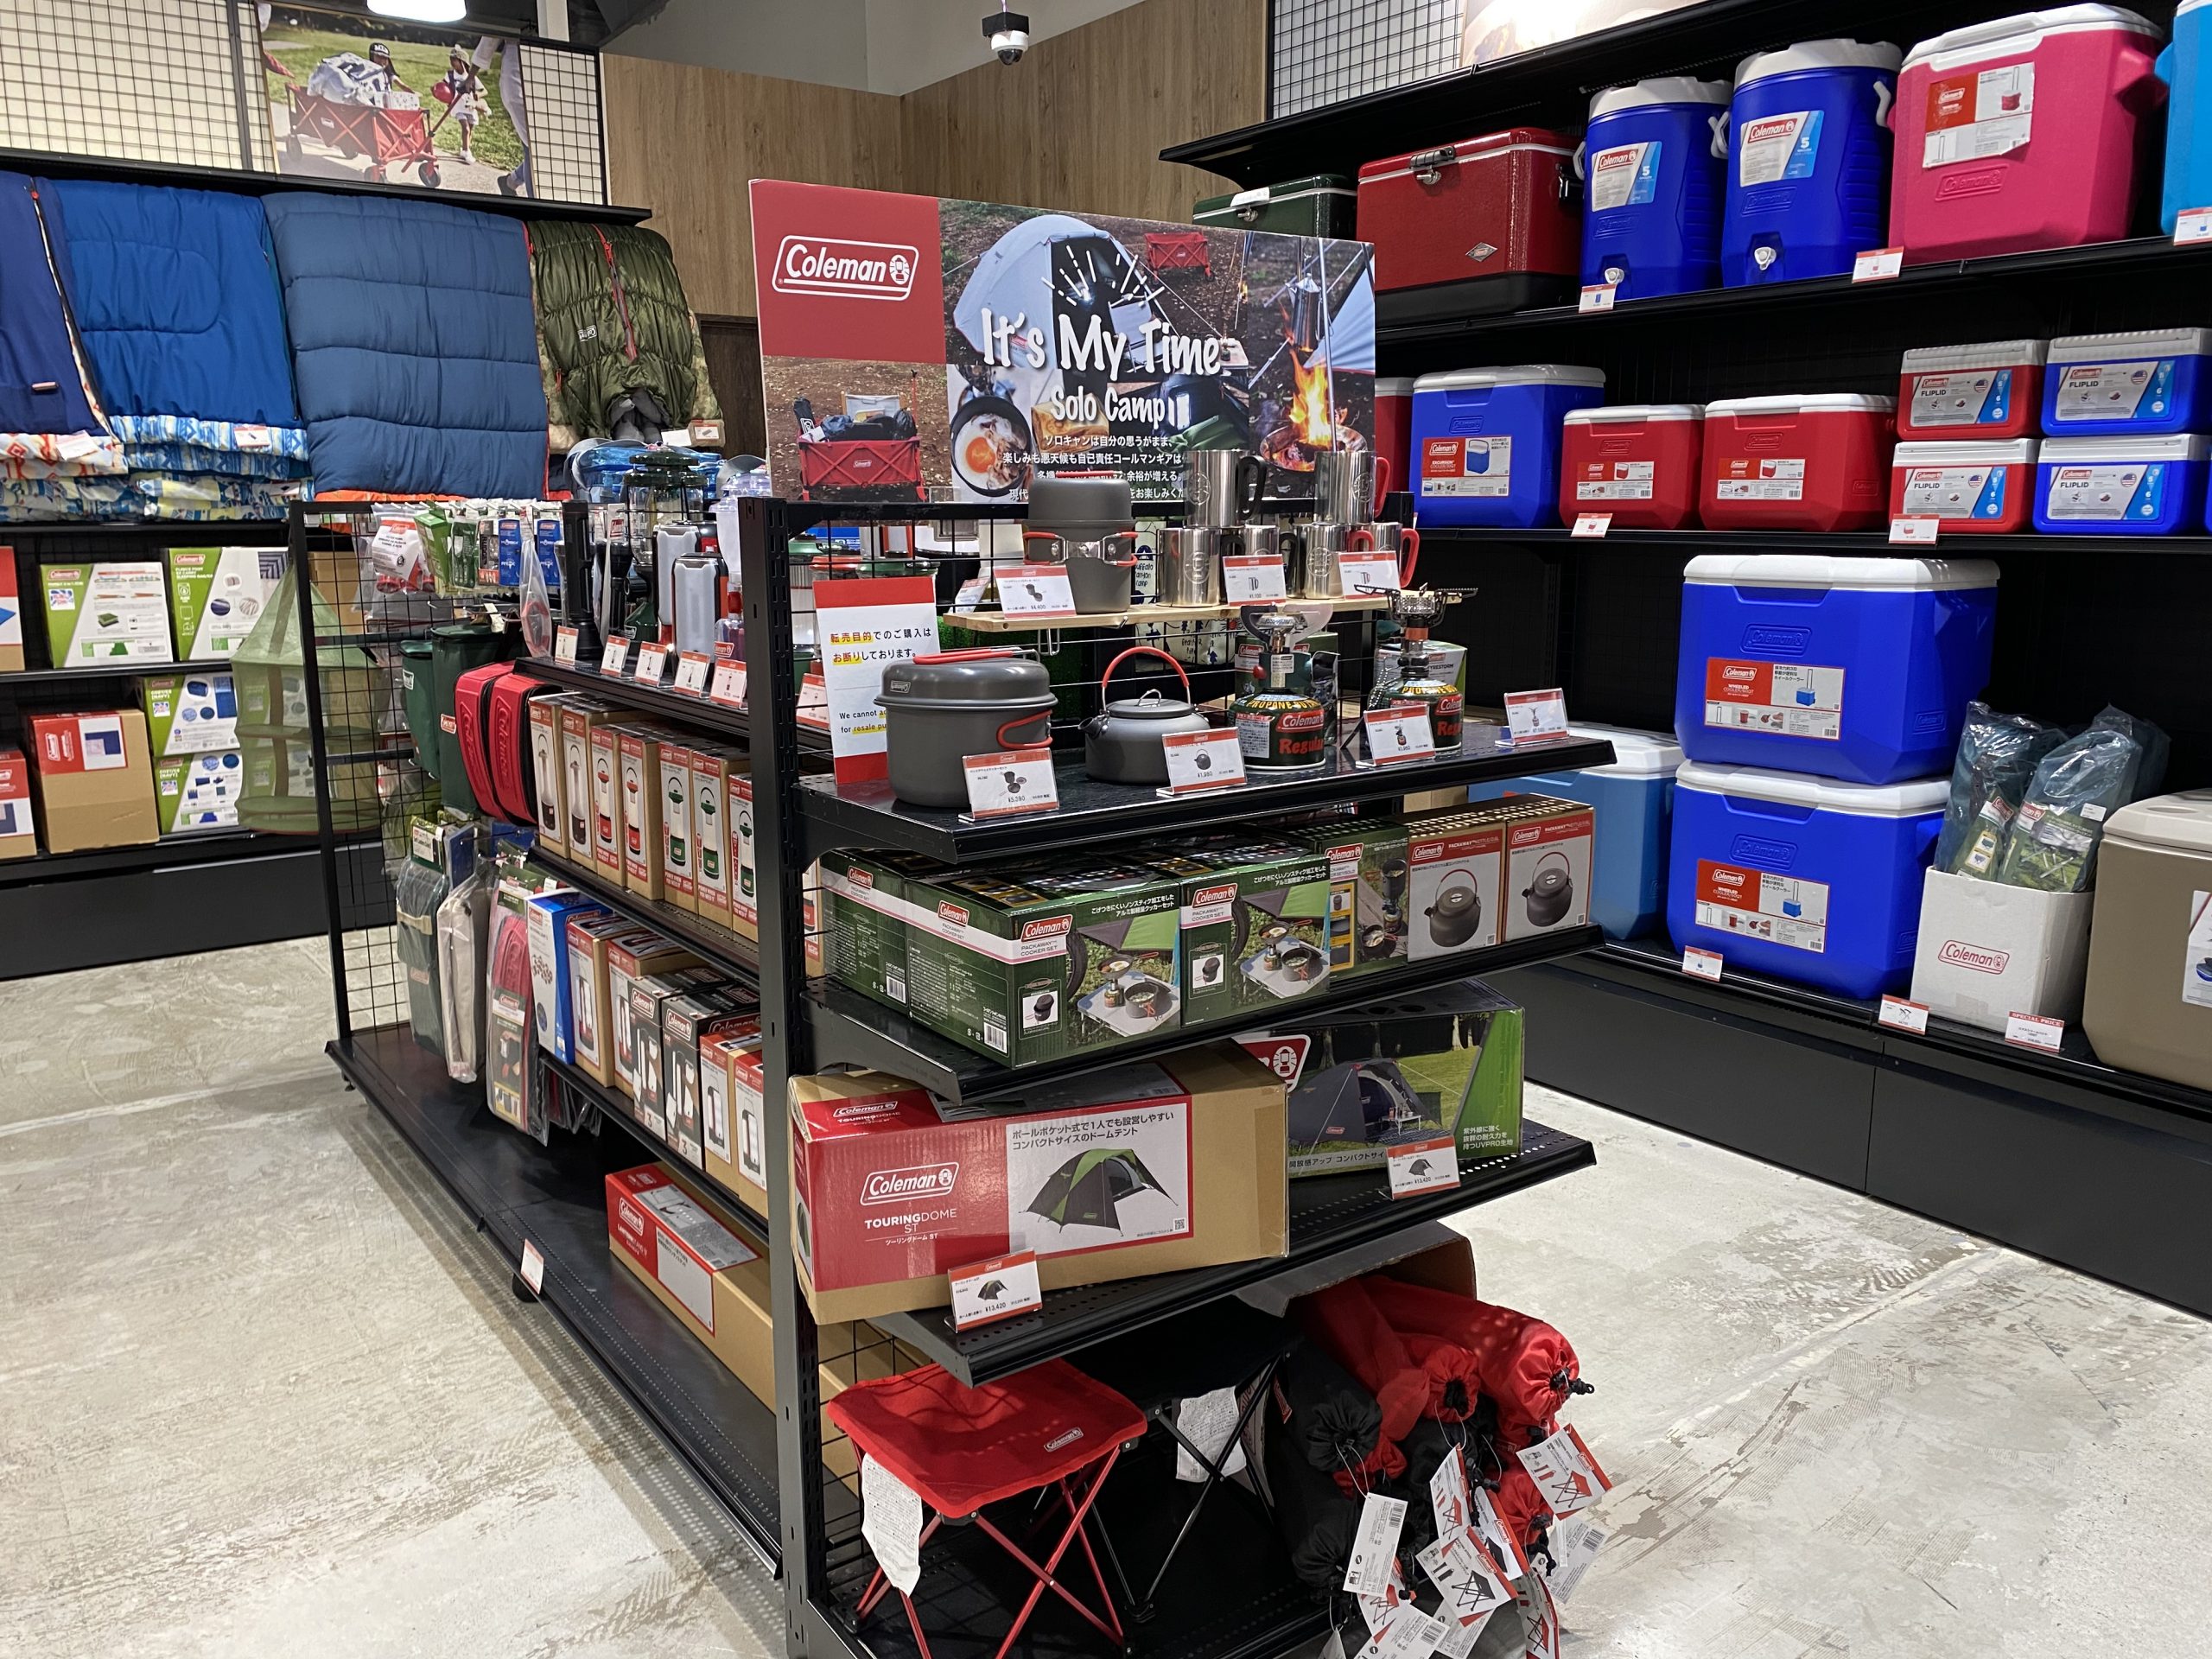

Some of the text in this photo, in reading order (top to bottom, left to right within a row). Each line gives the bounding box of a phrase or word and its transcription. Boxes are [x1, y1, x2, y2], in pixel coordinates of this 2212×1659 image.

[1750, 122, 1785, 139] Coleman
[1801, 137, 1810, 149] 5
[1599, 154, 1628, 168] Coleman
[1642, 166, 1650, 176] 5
[1943, 172, 1988, 193] Coleman
[785, 244, 886, 283] Coleman
[981, 308, 1222, 381] It's My Time
[1051, 386, 1166, 430] Solo Camp
[1045, 435, 1173, 448] ソロキャンは自分の思うがまま、
[1432, 444, 1452, 453] Coleman
[830, 627, 931, 644] 転売目的でのご購入は
[832, 648, 917, 664] お断りしております。
[1726, 668, 1750, 677] Coleman
[853, 709, 878, 719] cannot
[1283, 713, 1320, 727] Coleman
[854, 723, 876, 732] resale
[1514, 830, 1535, 842] Coleman
[1414, 847, 1438, 858] Coleman
[1715, 871, 1738, 882] Coleman
[1195, 891, 1227, 905] Coleman
[940, 905, 963, 922] Coleman
[1192, 913, 1213, 922] COOKER
[1025, 923, 1062, 938] Coleman
[1020, 944, 1058, 957] COOKER SET
[1945, 944, 1993, 967] Coleman
[632, 990, 650, 1012] Coleman
[668, 1013, 686, 1033] Coleman
[838, 1103, 884, 1116] Coleman
[1013, 1112, 1174, 1140] ポールポケット式で1人でも設営しやすい
[1463, 1124, 1500, 1135] 紫外線に強く
[1013, 1128, 1138, 1150] コンパクトサイズのドームテント
[1463, 1132, 1508, 1143] 抜群の耐久力を
[681, 1137, 688, 1154] 3
[1462, 1139, 1514, 1151] 持つUVPRO生地
[1288, 1158, 1332, 1168] 開放感アップ
[869, 1174, 938, 1196] Coleman
[620, 1201, 639, 1227] Coleman
[864, 1208, 957, 1229] TOURINGDOME
[904, 1223, 919, 1234] ST
[885, 1236, 928, 1245] ツーリングドーム
[1047, 1433, 1075, 1451] Coleman
